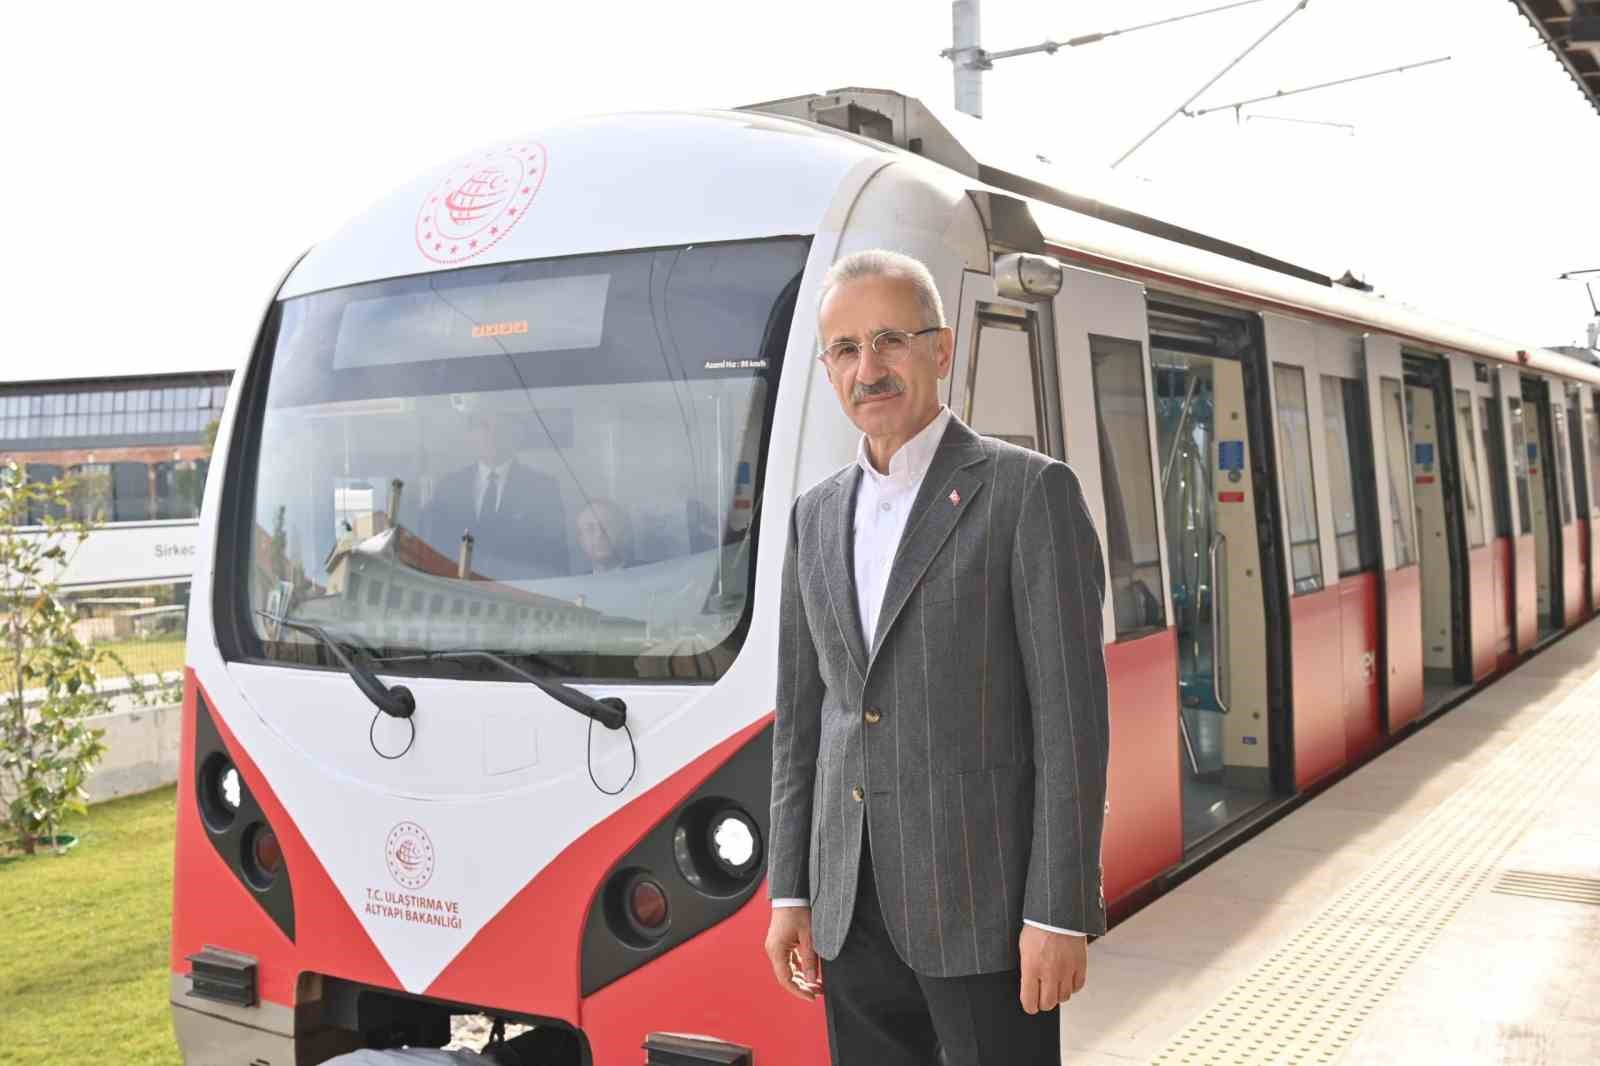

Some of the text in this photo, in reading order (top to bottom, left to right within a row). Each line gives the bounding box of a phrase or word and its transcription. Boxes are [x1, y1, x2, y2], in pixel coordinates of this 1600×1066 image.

[366, 888, 459, 914] T.C. ULAŞTIRMA VE
[365, 903, 463, 929] ALTYAPI BAKANLIĞI
